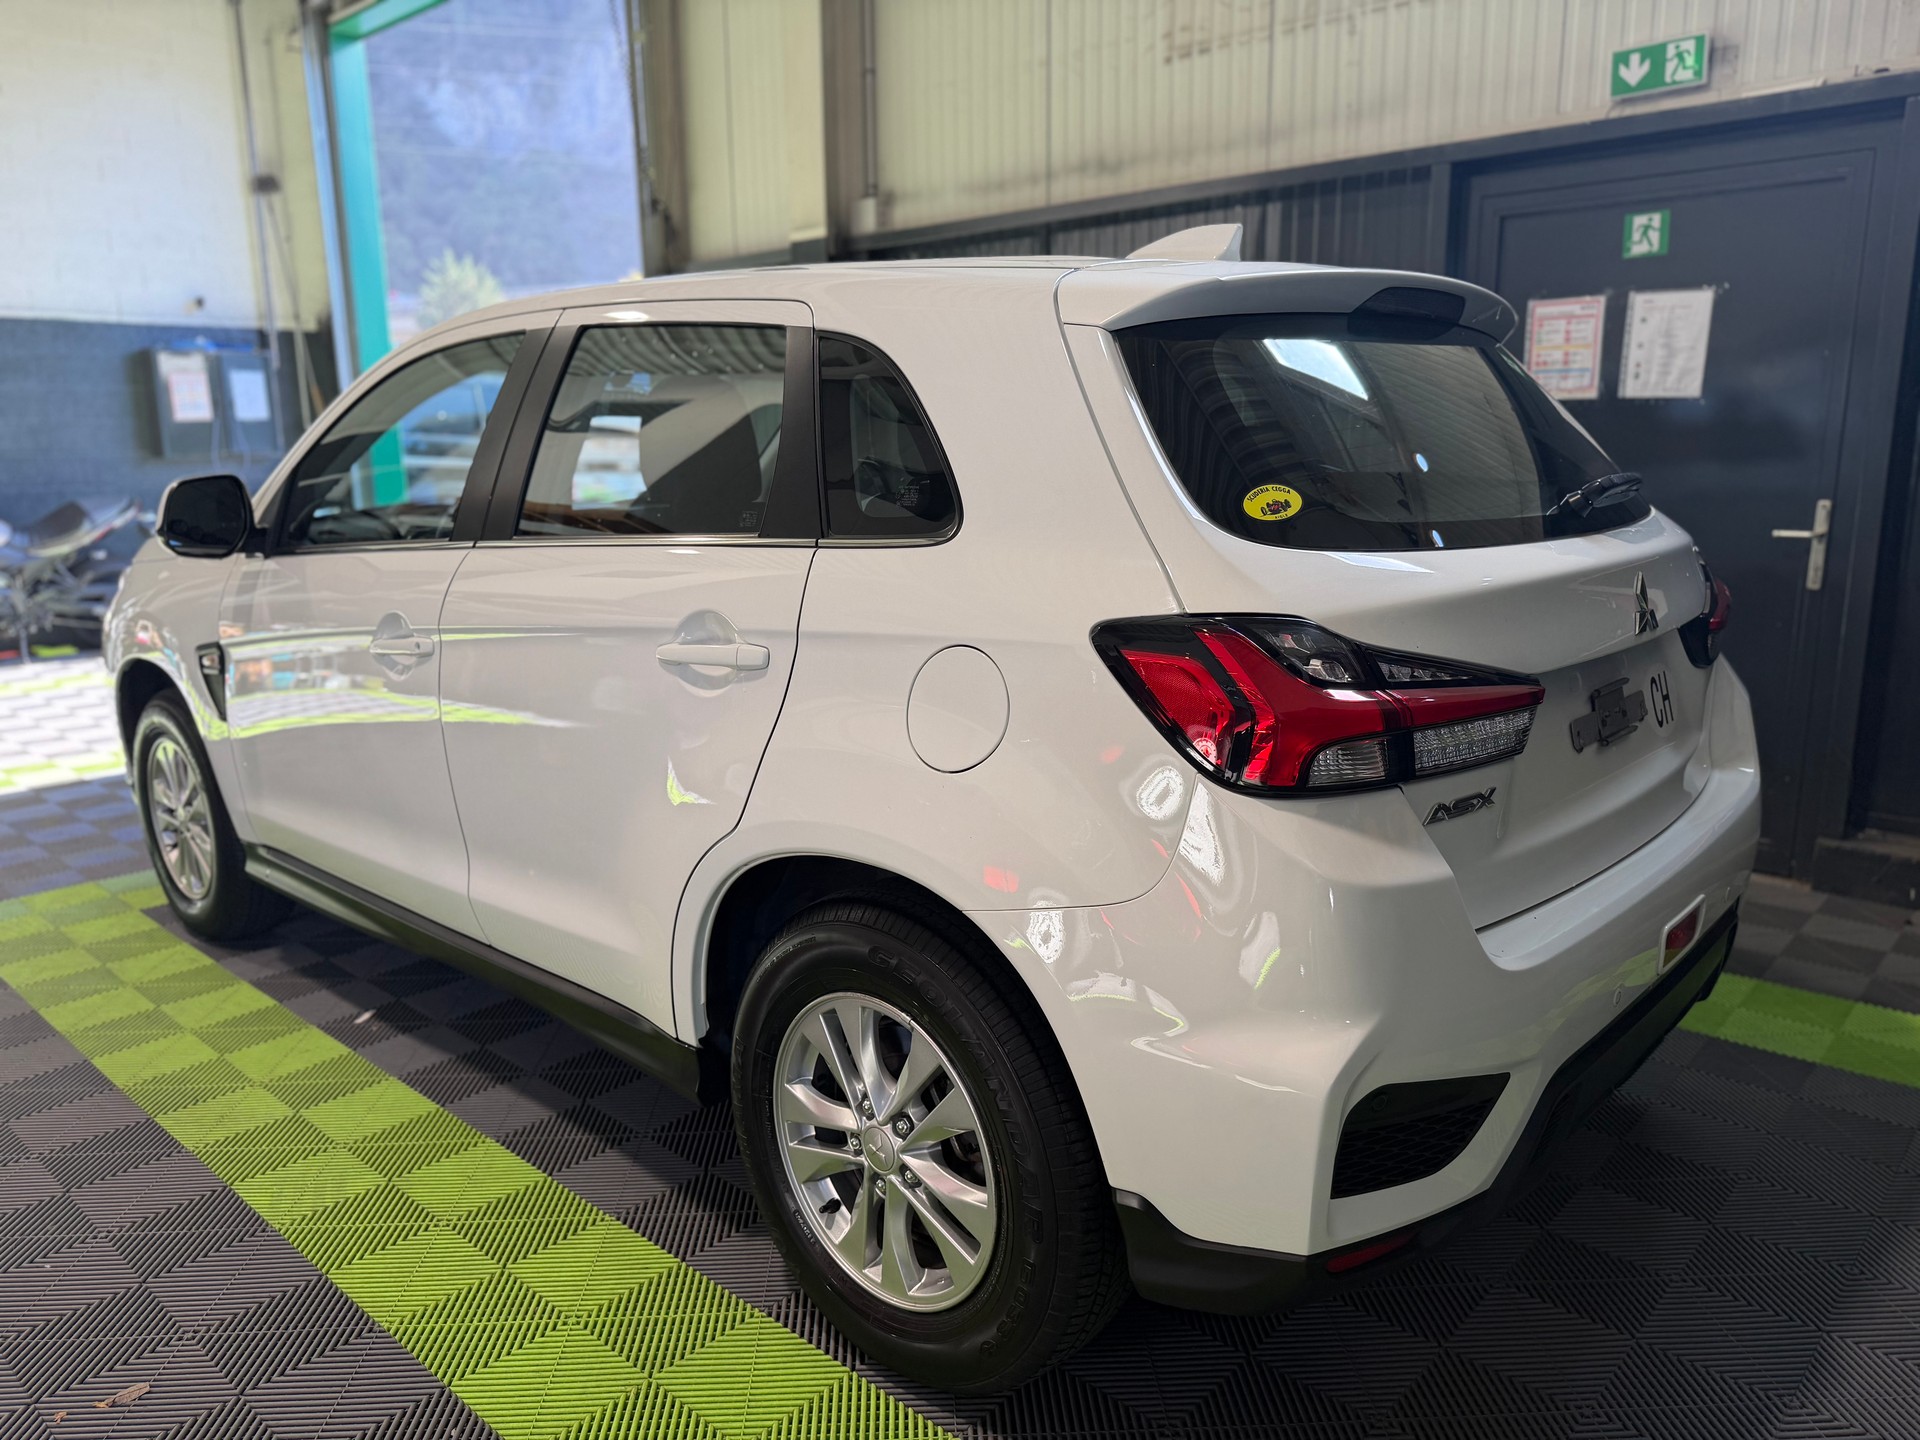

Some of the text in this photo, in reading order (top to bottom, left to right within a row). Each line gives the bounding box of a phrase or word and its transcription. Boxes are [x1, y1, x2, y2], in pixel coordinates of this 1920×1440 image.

[1650, 670, 1674, 729] CH
[1422, 787, 1497, 827] ASX
[869, 944, 1044, 1245] GEOLANDAR
